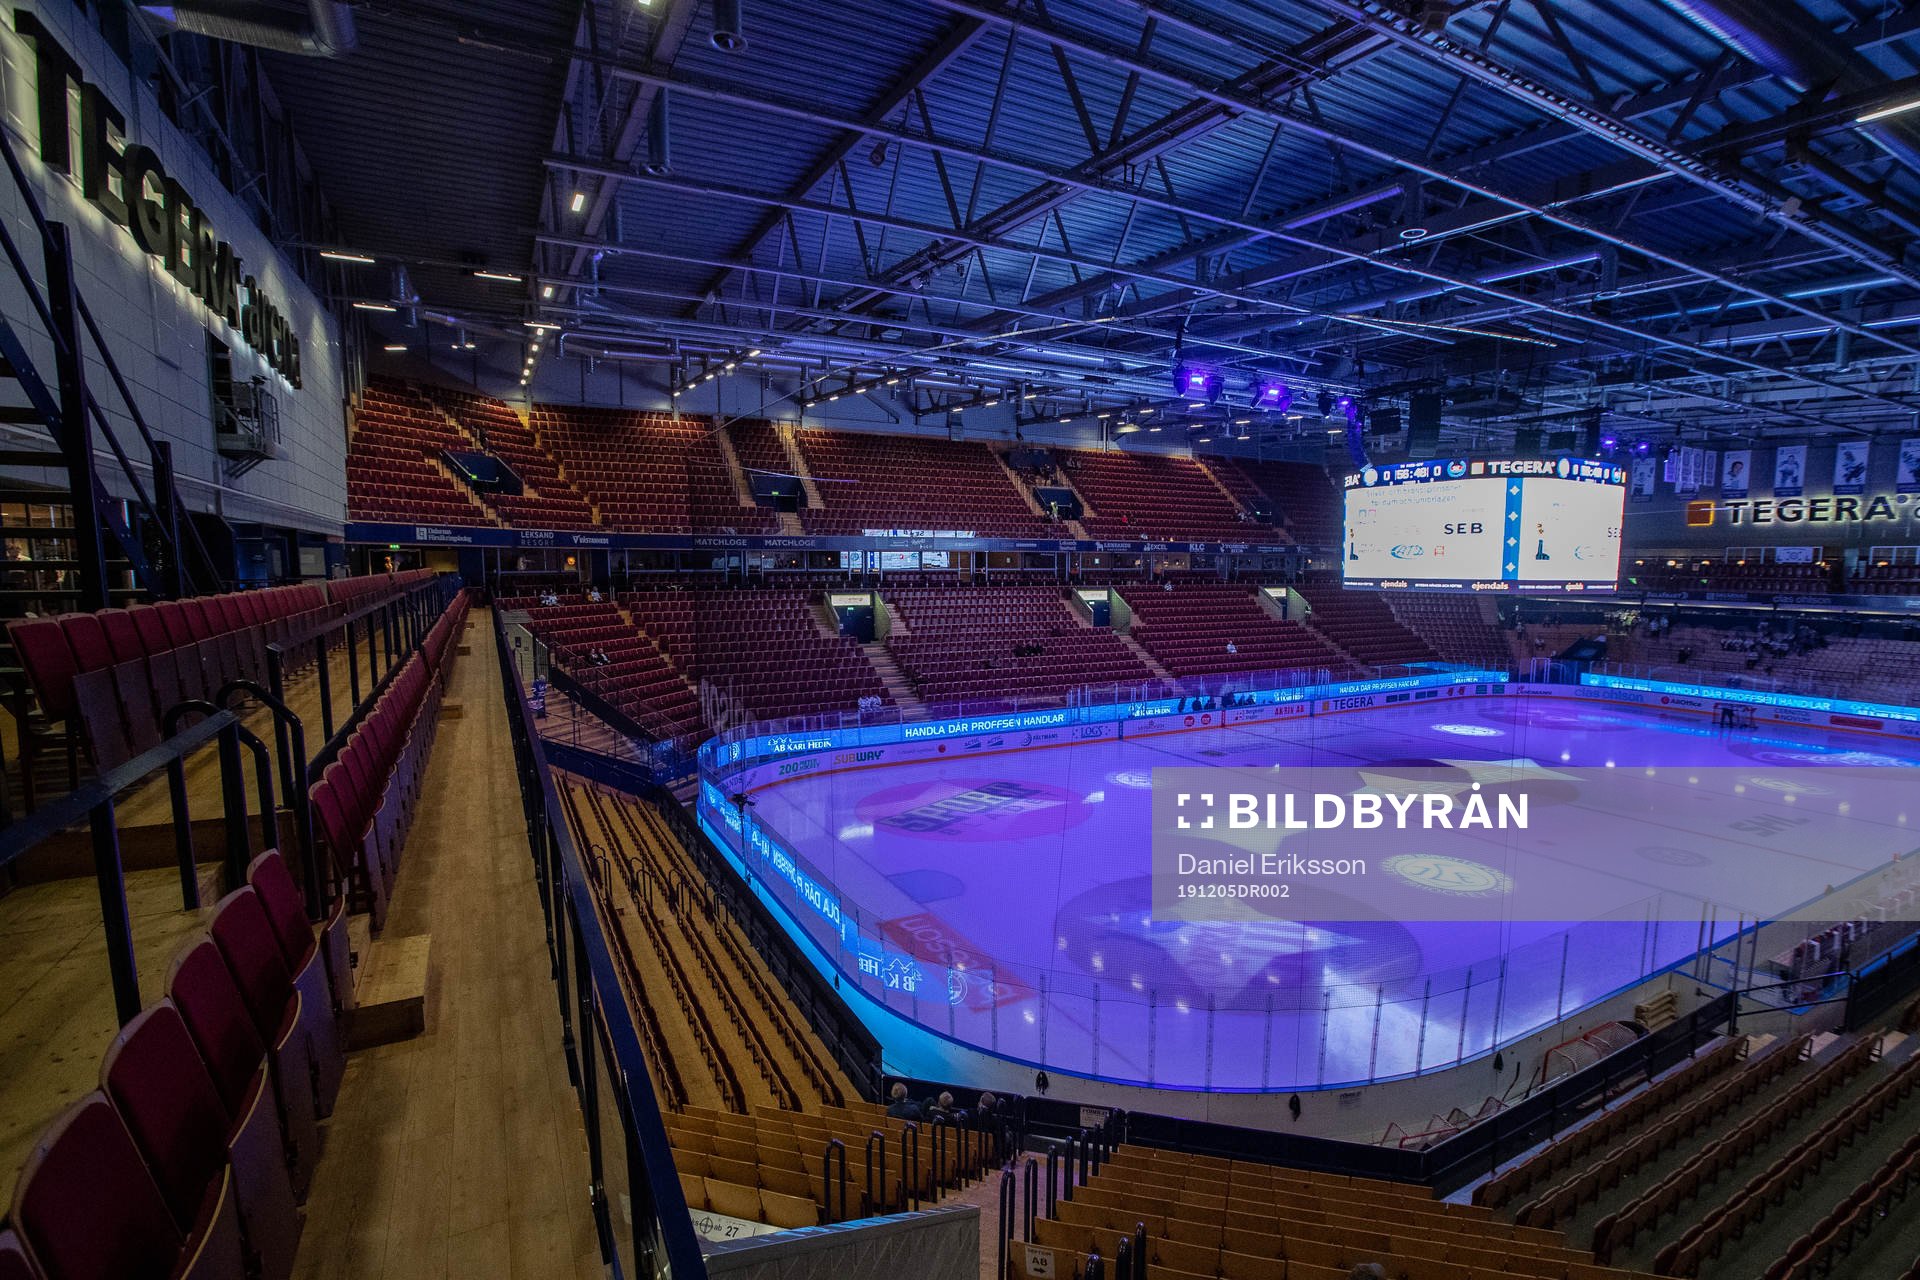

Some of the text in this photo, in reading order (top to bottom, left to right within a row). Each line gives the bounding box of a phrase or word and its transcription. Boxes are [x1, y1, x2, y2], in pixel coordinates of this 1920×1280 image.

[13, 8, 240, 331] TEGERA
[1488, 461, 1553, 474] TEGERA
[1724, 496, 1897, 524] TEGERA
[521, 531, 554, 539] LEKSAND
[1444, 522, 1483, 535] SEB
[694, 538, 747, 546] MATCHLOGE
[764, 539, 816, 547] MATCHLOGE
[1472, 582, 1509, 590] ejendals
[1665, 685, 1699, 696] HANDLA
[1334, 697, 1374, 710] TEGERA
[905, 713, 1065, 737] HANDLA DÄR PROFFSEN HANDLAR
[774, 743, 786, 752] AB
[808, 740, 832, 749] HEDIN
[834, 750, 884, 765] SUBWAY
[725, 1225, 739, 1238] 27
